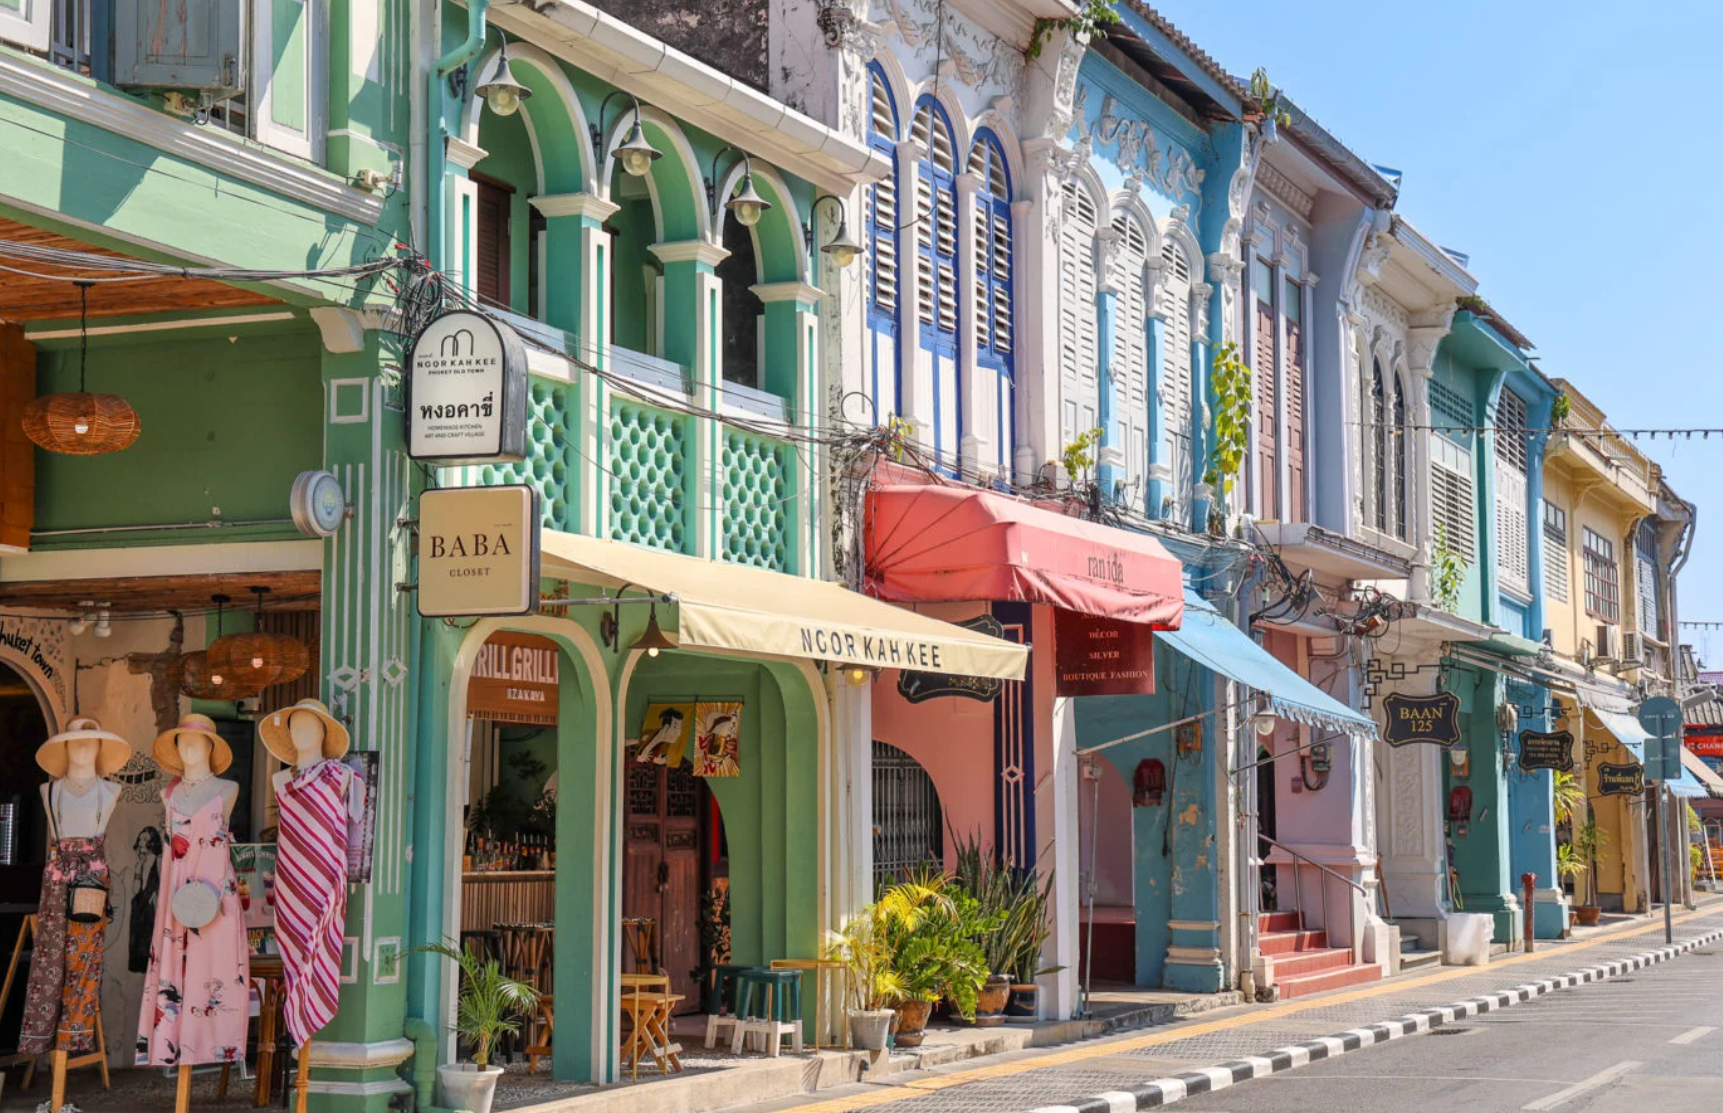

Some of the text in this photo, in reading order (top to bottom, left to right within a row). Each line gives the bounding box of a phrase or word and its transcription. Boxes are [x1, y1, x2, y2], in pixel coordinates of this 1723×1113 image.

[417, 358, 497, 368] NGOR KAH KEE
[429, 533, 511, 558] BABA
[449, 567, 491, 577] CLOSET
[0, 620, 54, 679] huket town
[800, 627, 942, 668] NGOR KAH KEE
[472, 643, 510, 680] RILL
[1088, 651, 1120, 660] SILVER
[1063, 669, 1149, 682] BOUTIQUE FASHION
[506, 688, 545, 701] IZAKAYA
[1400, 707, 1443, 719] BAAN
[1411, 720, 1433, 732] 125
